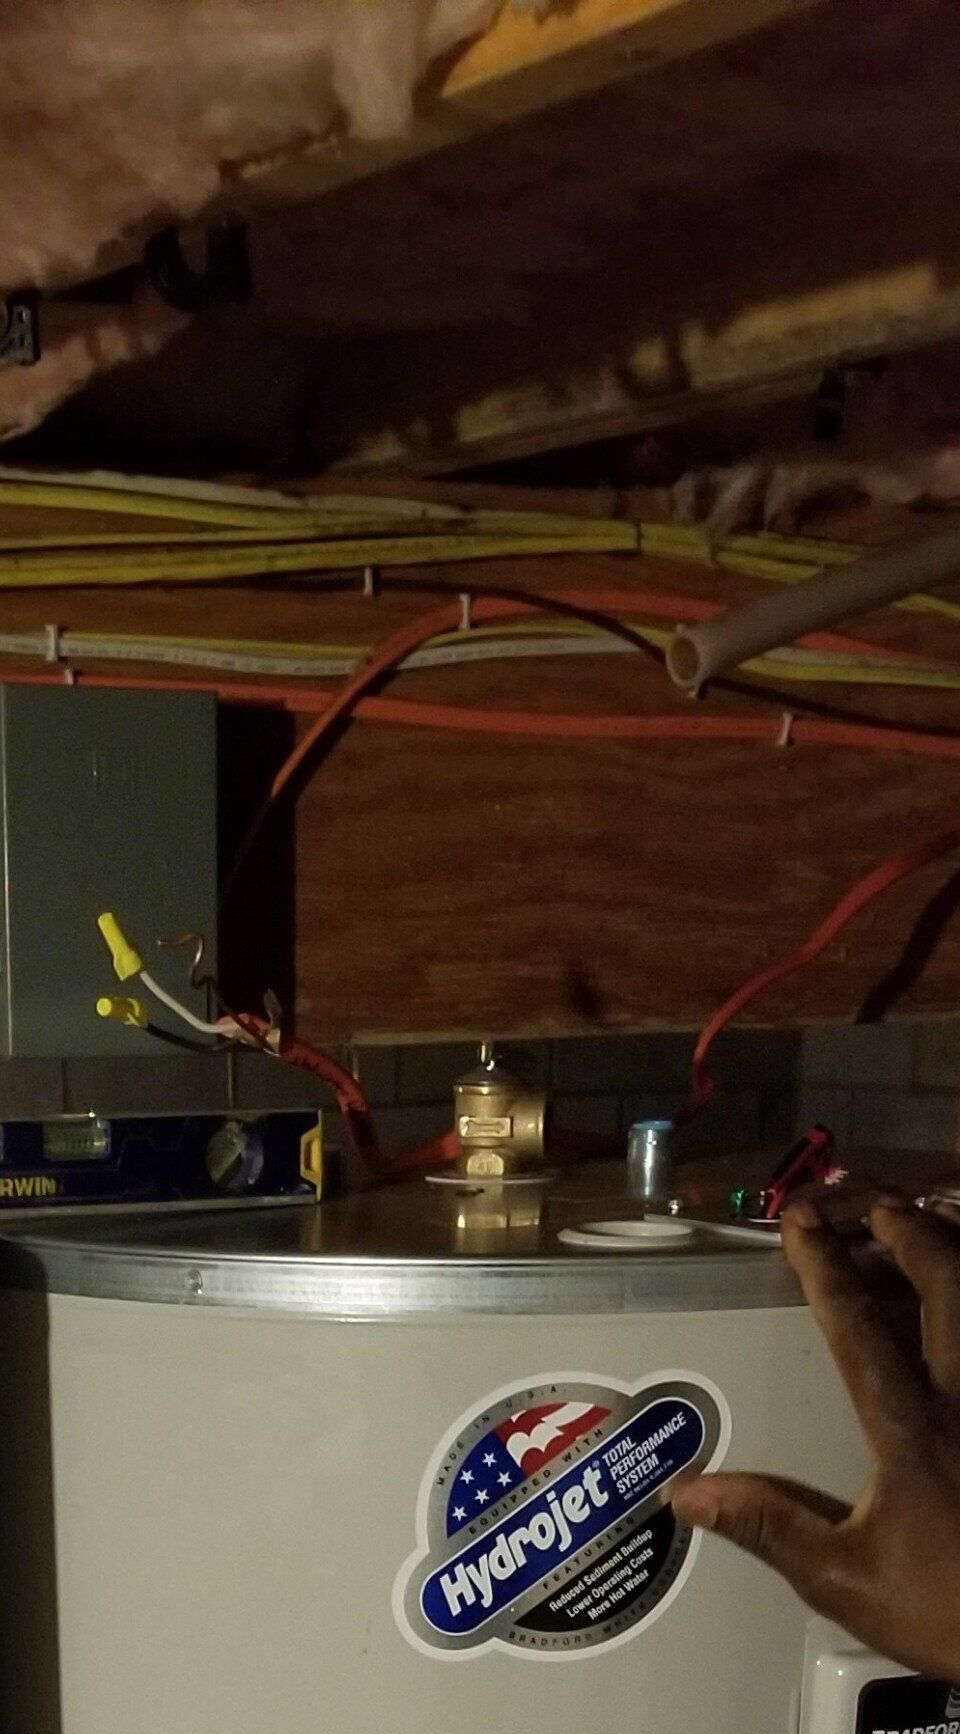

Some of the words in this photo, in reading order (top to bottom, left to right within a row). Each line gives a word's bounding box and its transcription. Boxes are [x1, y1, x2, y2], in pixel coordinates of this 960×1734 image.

[436, 1441, 465, 1486] MADE
[473, 1414, 490, 1430] IN
[602, 1436, 637, 1467] TOTAL
[609, 1411, 686, 1480] PERFORMANCE
[616, 1452, 660, 1494] SYSTEM
[468, 1469, 551, 1535] EQUIPPED
[562, 1428, 604, 1462] WITH
[439, 1465, 609, 1617] Hydrojet
[542, 1516, 635, 1590] FEATURING
[549, 1579, 586, 1612] Reduced
[583, 1551, 623, 1586] Sediment
[620, 1529, 653, 1558] Buildup
[566, 1593, 593, 1618] Lower
[591, 1564, 633, 1599] Operating
[629, 1547, 654, 1569] Costs
[587, 1599, 611, 1621] More
[609, 1588, 627, 1605] Hot
[623, 1569, 650, 1594] Water
[509, 1631, 592, 1646] BRADFORD
